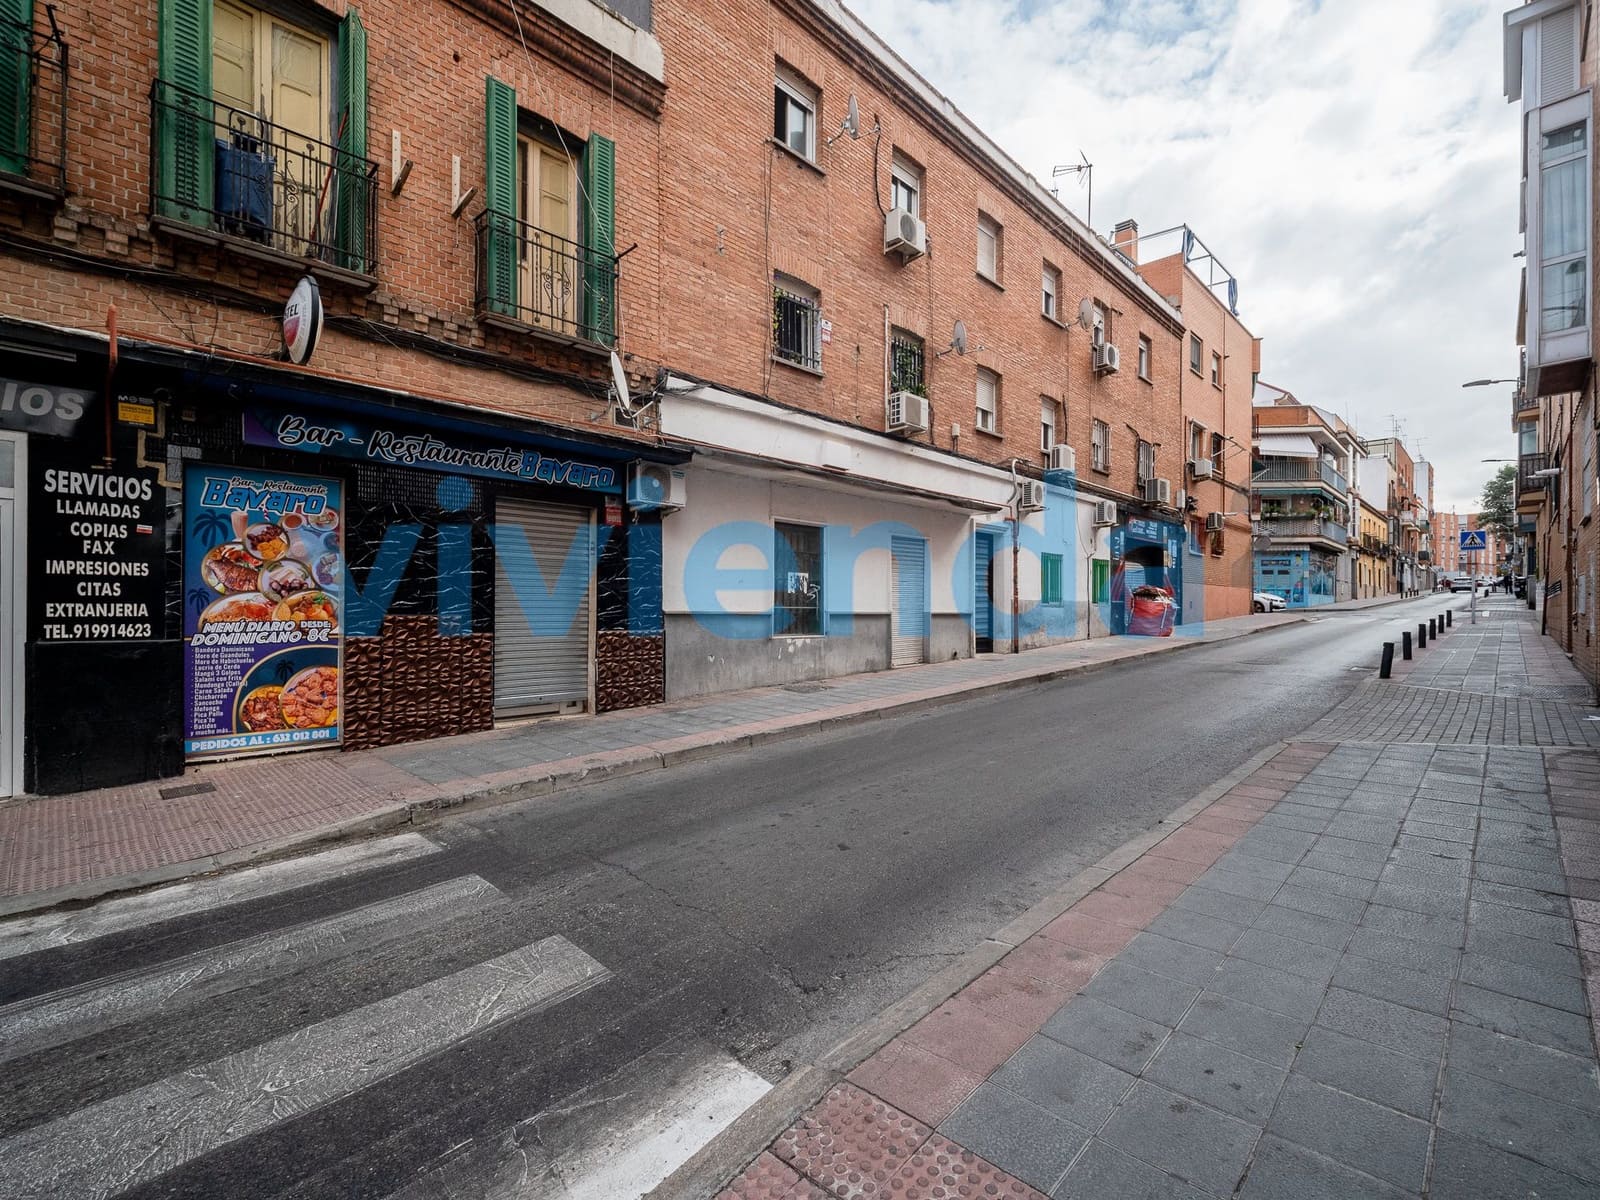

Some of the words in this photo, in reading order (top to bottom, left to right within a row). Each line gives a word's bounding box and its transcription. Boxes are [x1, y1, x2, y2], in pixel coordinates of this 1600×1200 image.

[278, 414, 345, 447] Bar
[367, 430, 523, 473] Restaurante
[519, 450, 615, 489] Bavaro
[44, 469, 152, 501] SERVICIOS
[231, 476, 254, 487] Bar
[263, 479, 328, 495] Restaurante
[200, 476, 327, 516] Bavaro
[57, 499, 140, 519] LLAMADAS
[70, 521, 128, 539] COPIAS
[83, 540, 115, 555] FAX
[46, 560, 149, 576] IMPRESIONES
[77, 581, 121, 596] CITAS
[46, 603, 149, 617] EXTRANJERIA
[43, 623, 152, 639] TEL.919914623
[202, 619, 246, 633] MENÚ
[246, 620, 296, 633] DIARIO
[300, 620, 331, 628] DESDE:
[190, 630, 302, 646] DOMINICANO
[307, 628, 330, 642] 8€
[191, 736, 247, 751] PEDIDOS
[248, 735, 265, 746] AL
